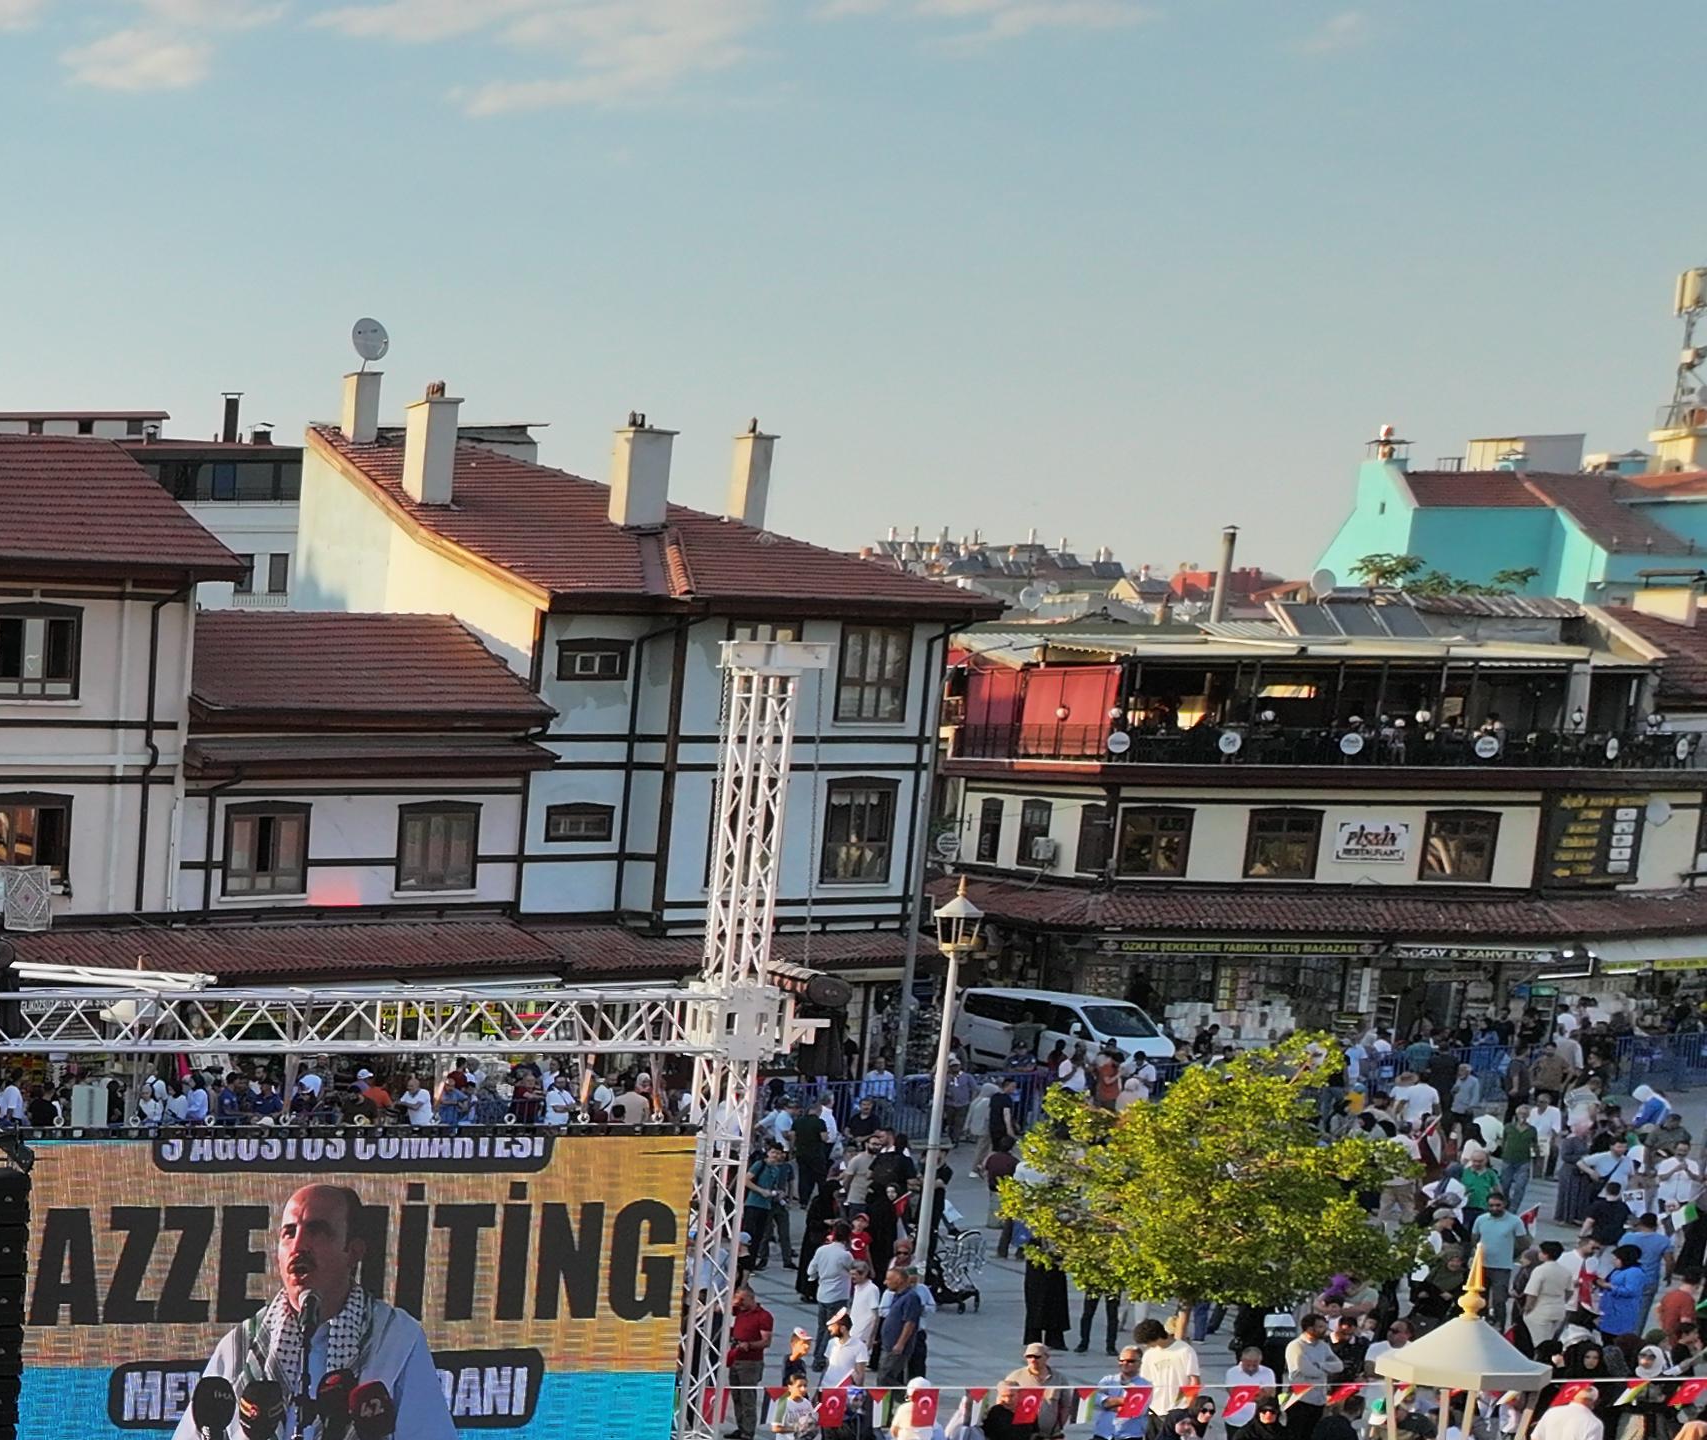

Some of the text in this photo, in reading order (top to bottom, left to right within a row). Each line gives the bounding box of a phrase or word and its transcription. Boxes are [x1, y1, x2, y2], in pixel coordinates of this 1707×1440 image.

[1160, 942, 1221, 953] ŞEKERLEME
[1464, 950, 1512, 959] KAHVE
[361, 1398, 384, 1417] 42
